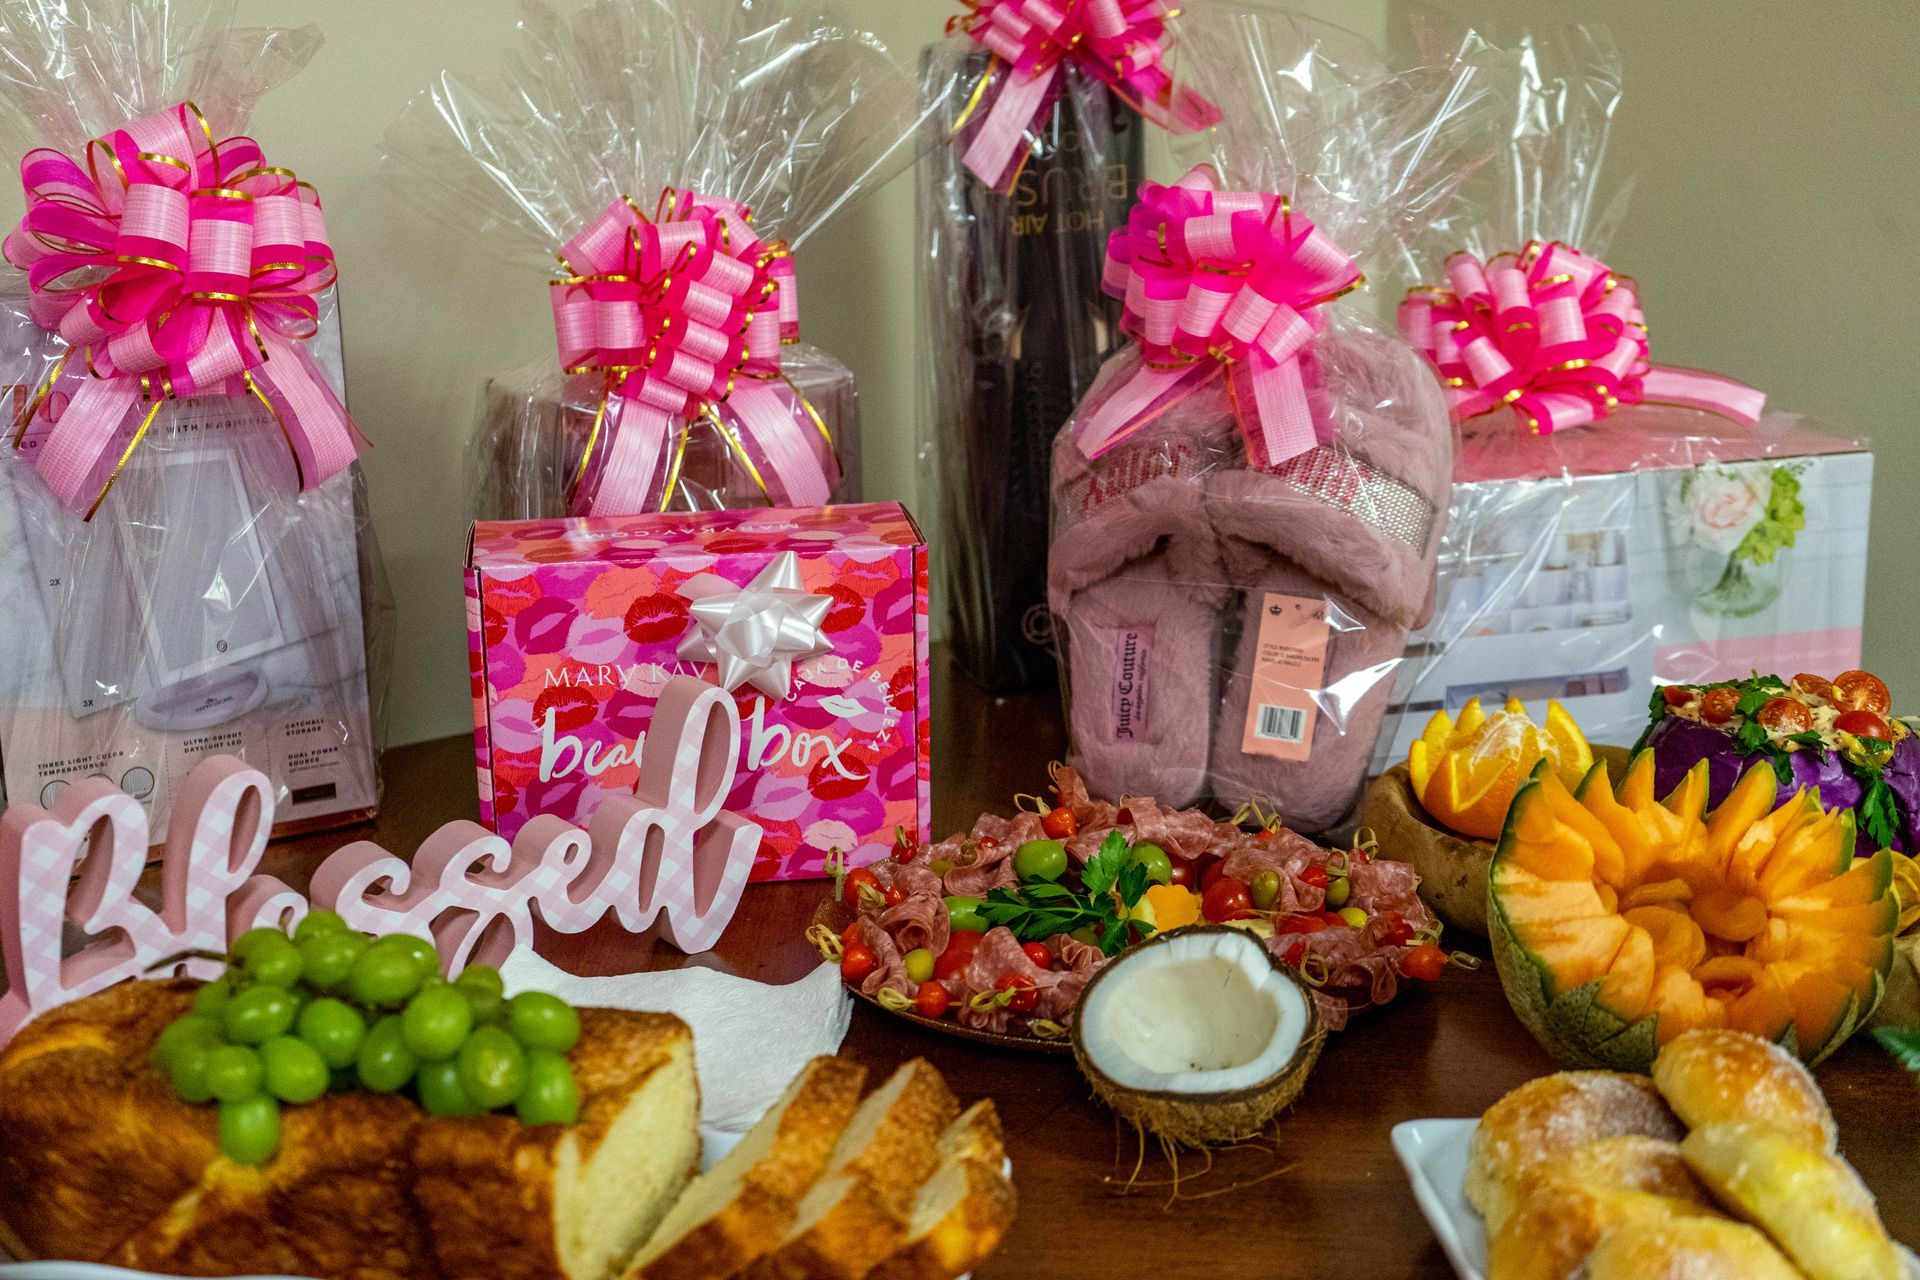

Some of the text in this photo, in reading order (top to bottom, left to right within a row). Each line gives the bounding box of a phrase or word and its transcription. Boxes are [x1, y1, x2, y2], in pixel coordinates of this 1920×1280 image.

[1011, 163, 1128, 206] BRUS
[1008, 213, 1048, 236] AIR
[166, 422, 199, 435] WITH
[49, 578, 61, 587] 2X
[543, 664, 637, 690] MARY
[1116, 632, 1138, 739] Juicy Couture
[82, 699, 94, 708] 3X
[785, 657, 897, 752] CAJA DE BELLEZA
[285, 718, 325, 730] CATCHALL
[286, 725, 322, 737] STORAGE
[184, 739, 242, 753] DAYLIGHT LED
[530, 695, 871, 784] bea box
[38, 750, 124, 770] THREE LIGHT COLOR
[288, 746, 338, 760] DUAL POWER
[288, 757, 320, 768] SOURCE
